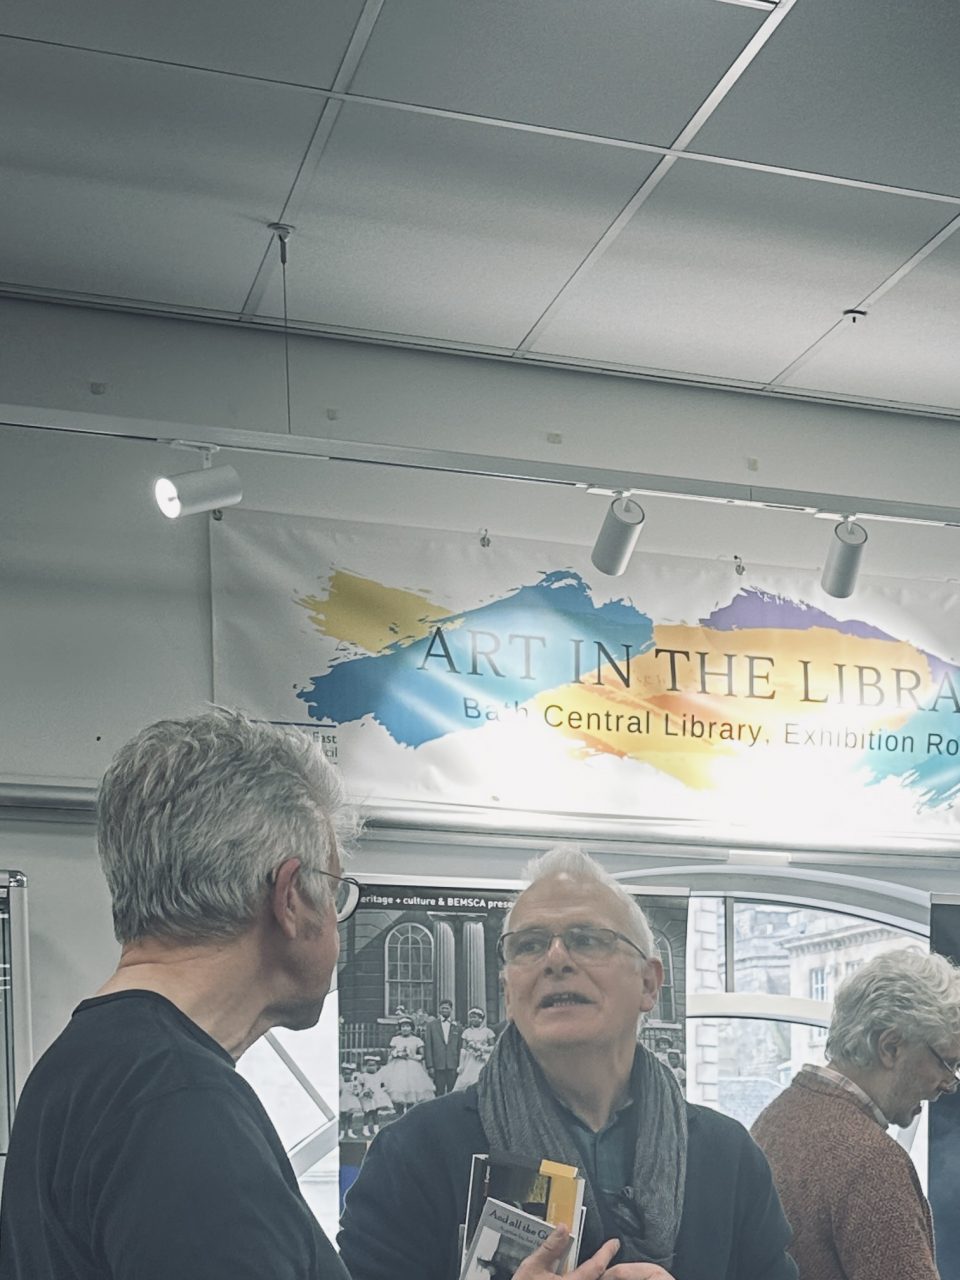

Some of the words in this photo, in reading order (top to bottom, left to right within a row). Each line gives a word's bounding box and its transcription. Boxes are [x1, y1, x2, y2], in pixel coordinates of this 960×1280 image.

[417, 626, 547, 681] ART
[569, 638, 633, 689] IN
[654, 648, 776, 700] THE
[543, 704, 651, 734] Central
[663, 713, 770, 748] Library,
[784, 722, 915, 754] Exhibition
[360, 895, 394, 906] eritage
[402, 896, 436, 906] culture
[437, 897, 445, 906] &
[447, 897, 486, 908] BEMSCA
[487, 900, 515, 910] prese
